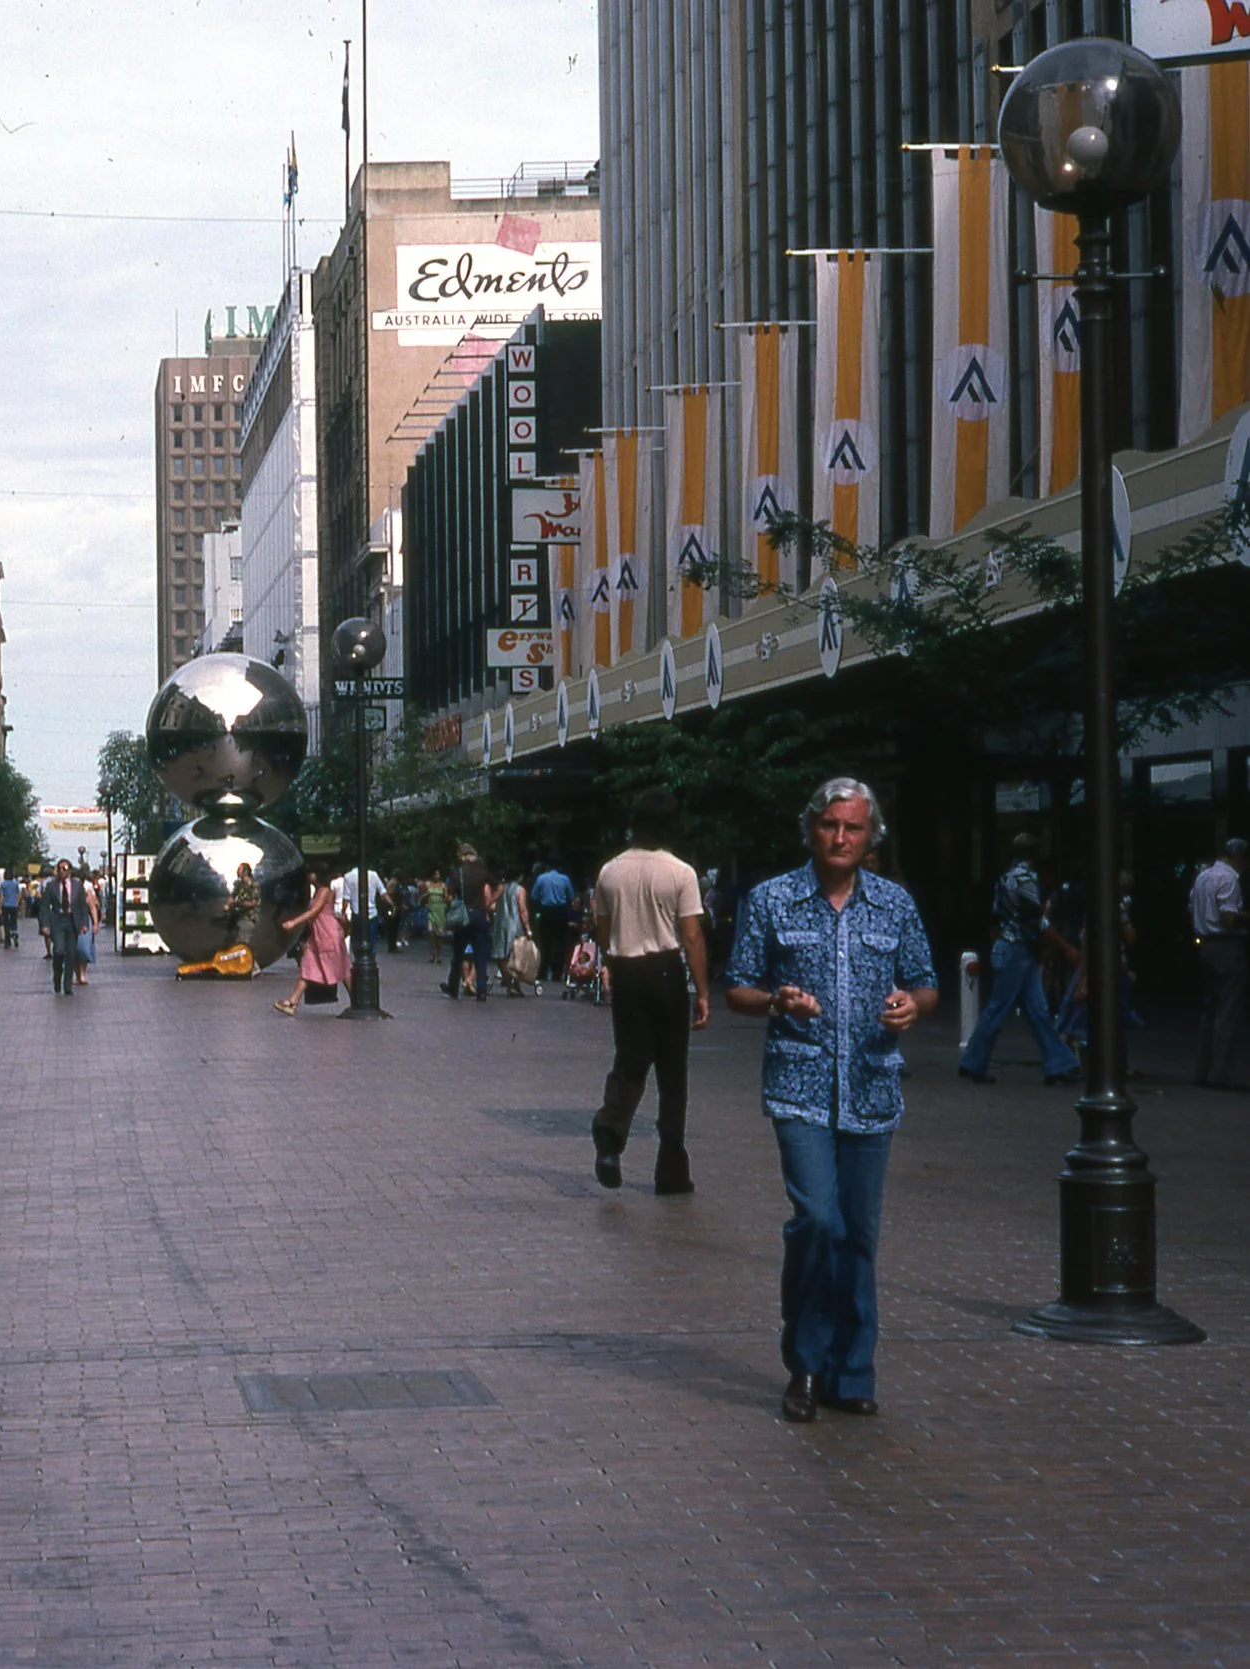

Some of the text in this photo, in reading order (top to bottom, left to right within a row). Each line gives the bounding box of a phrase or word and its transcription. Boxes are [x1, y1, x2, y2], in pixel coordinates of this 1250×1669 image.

[408, 252, 590, 303] Edments
[384, 315, 466, 327] AUSTRALIA
[174, 375, 245, 393] IMFC
